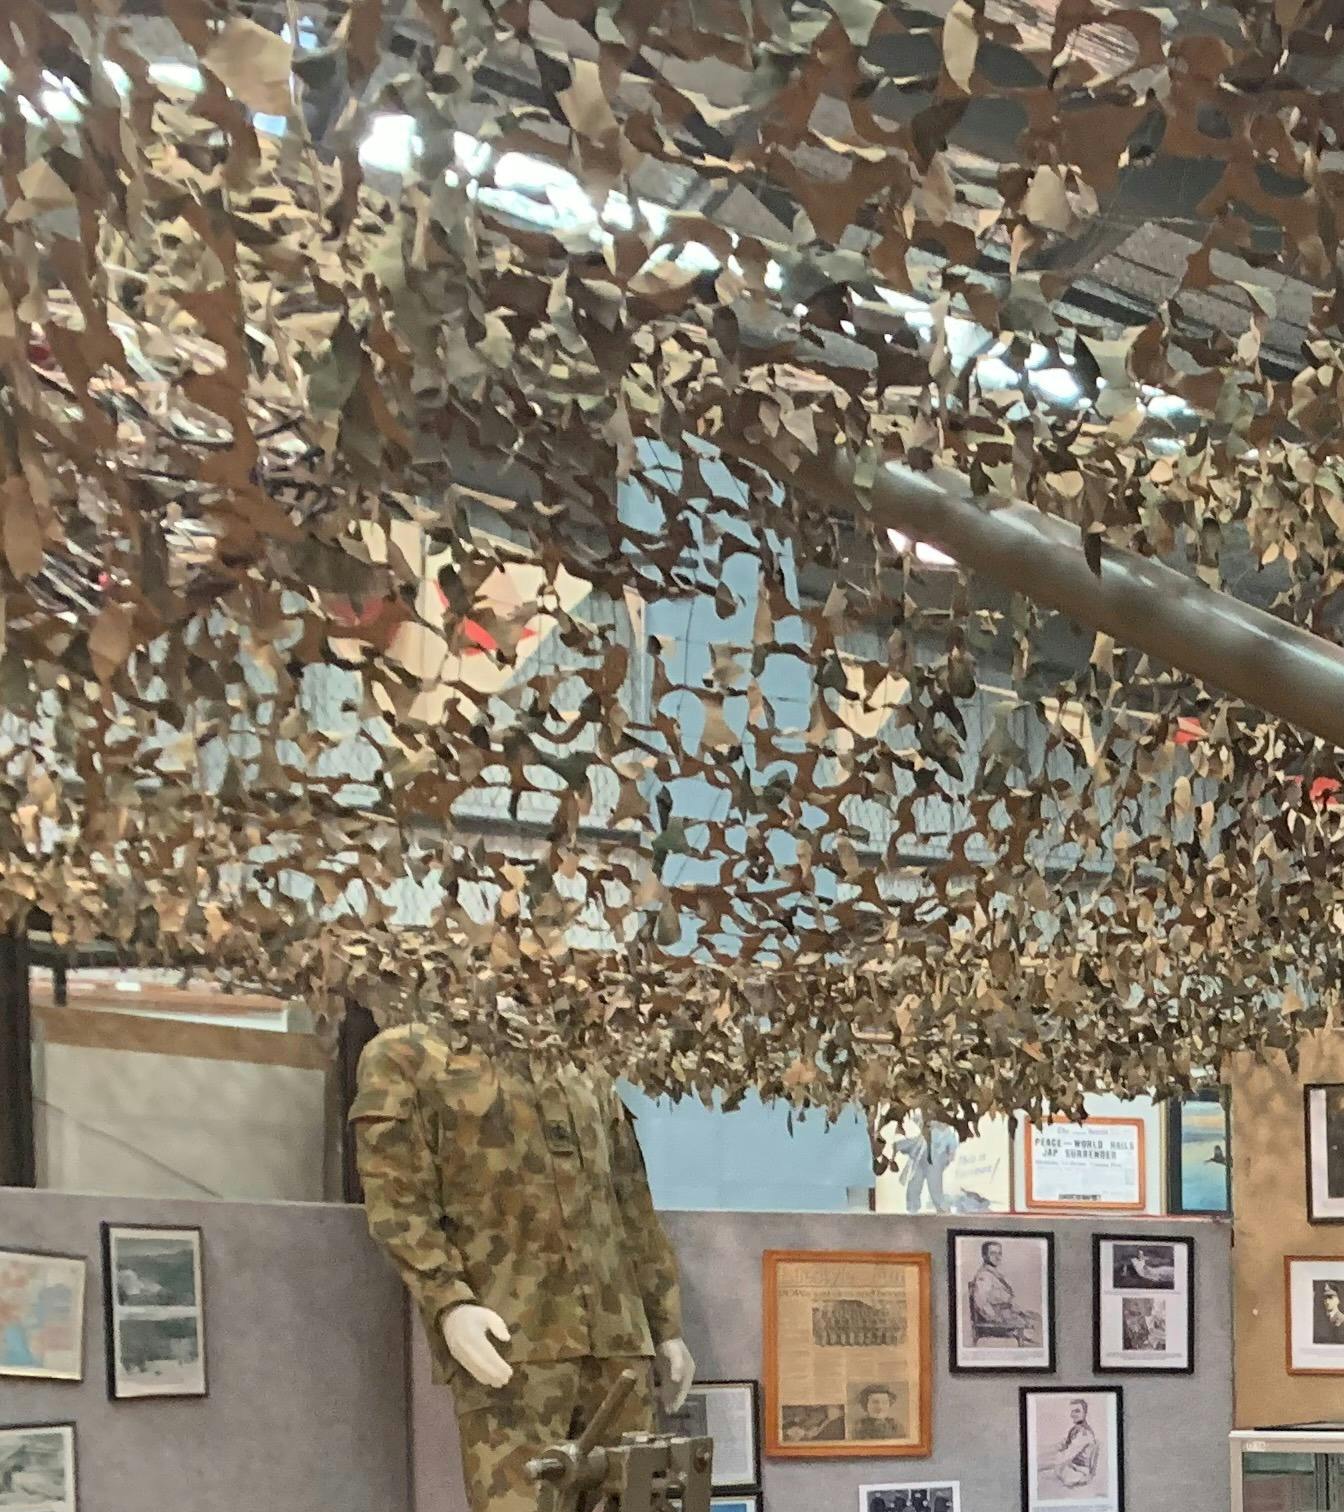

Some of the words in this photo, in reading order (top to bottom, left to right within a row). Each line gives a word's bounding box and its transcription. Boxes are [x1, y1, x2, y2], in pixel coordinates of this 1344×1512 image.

[1034, 1138, 1061, 1148] PEACE
[1074, 1139, 1103, 1150] WORLD
[1042, 1148, 1058, 1157] JAP
[1065, 1149, 1116, 1160] SURRENDER
